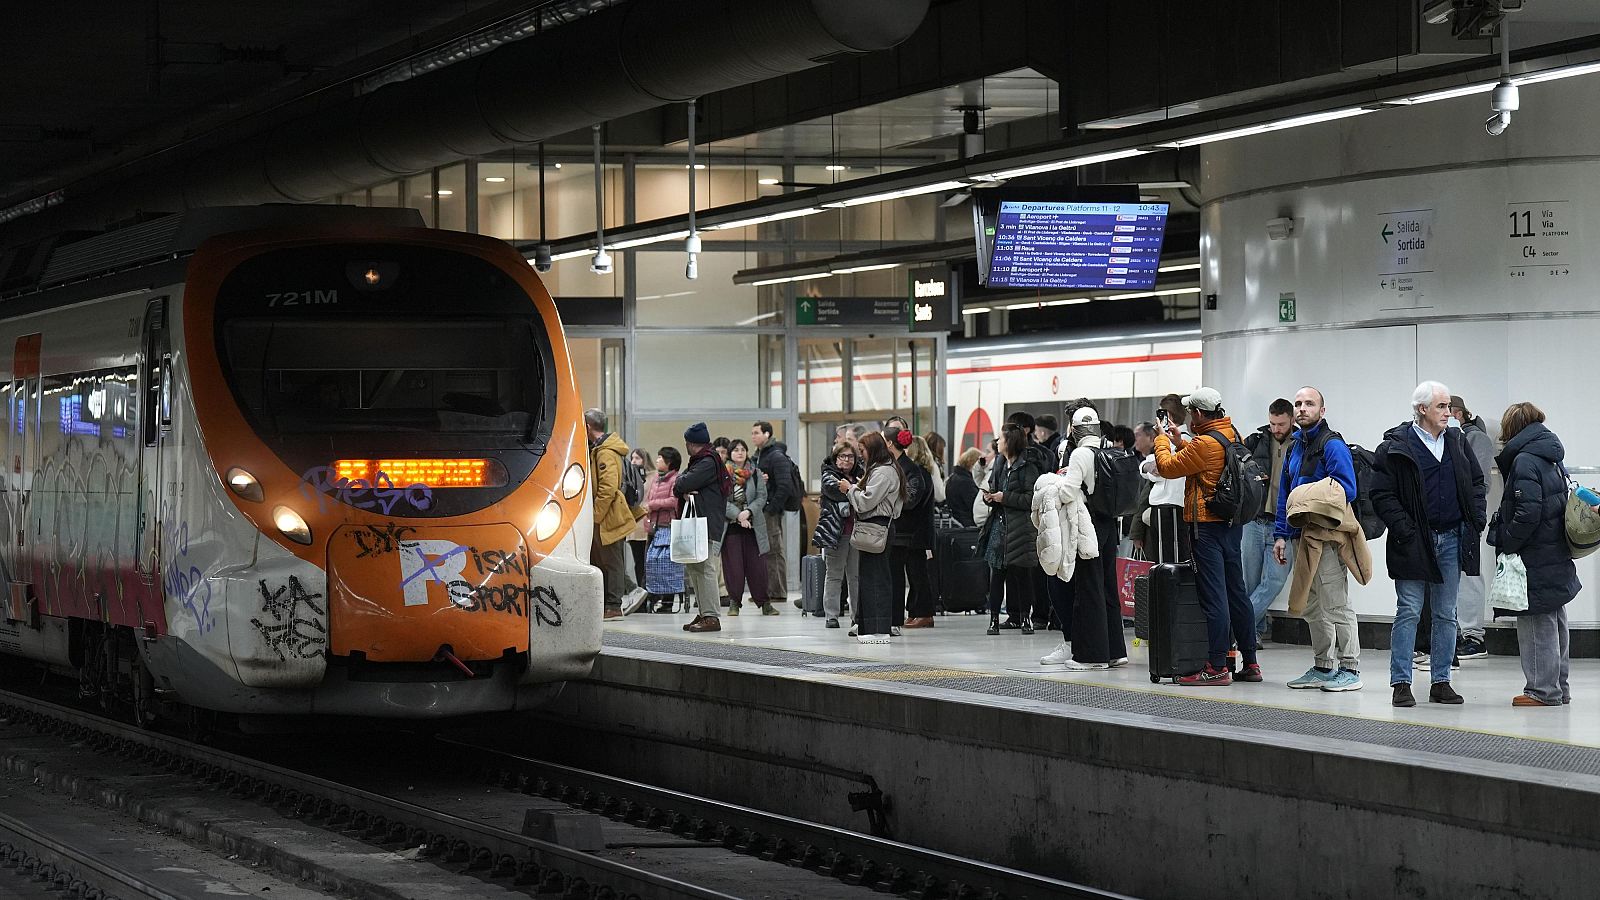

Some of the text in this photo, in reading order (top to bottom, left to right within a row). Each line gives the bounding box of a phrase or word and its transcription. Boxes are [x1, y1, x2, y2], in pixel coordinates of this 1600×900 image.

[1397, 220, 1420, 233] Salida
[1510, 210, 1535, 237] 11
[1398, 238, 1425, 250] Sortida
[1523, 246, 1536, 257] C4
[265, 290, 338, 307] 721M
[446, 581, 562, 627] SPORTS
